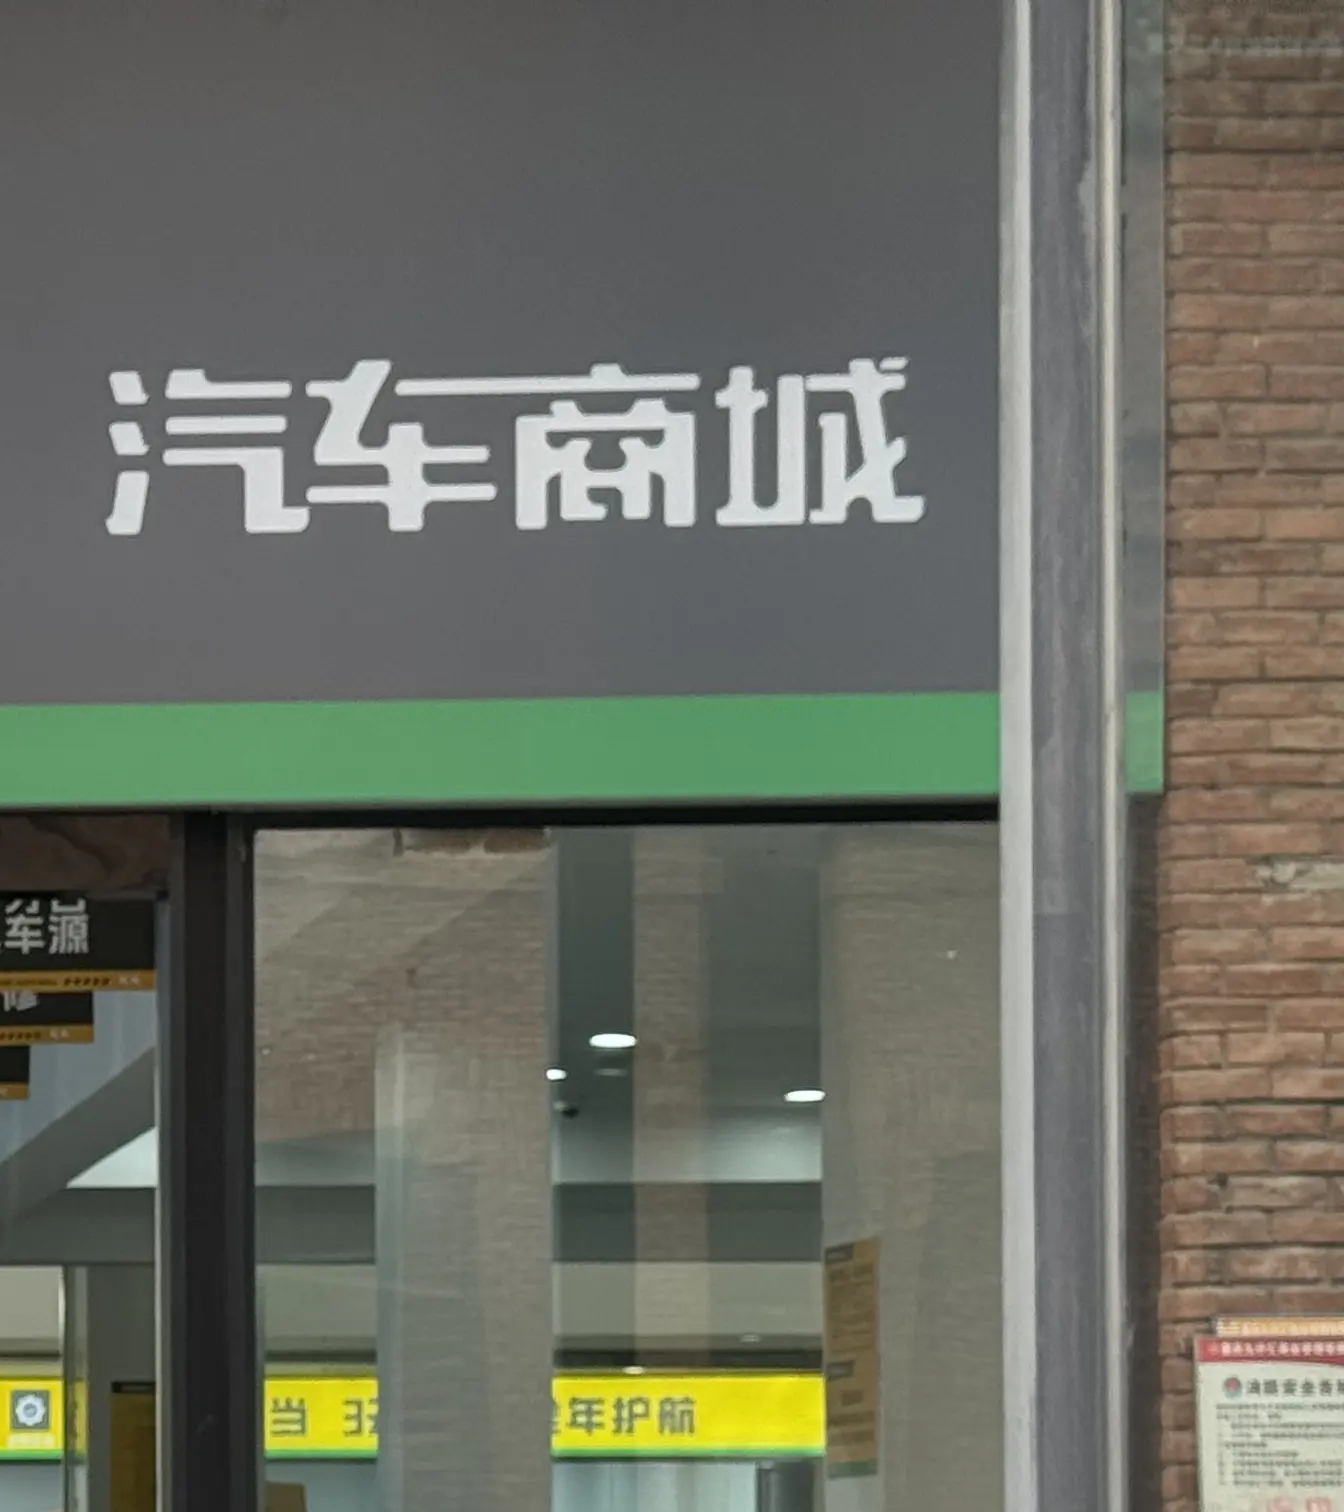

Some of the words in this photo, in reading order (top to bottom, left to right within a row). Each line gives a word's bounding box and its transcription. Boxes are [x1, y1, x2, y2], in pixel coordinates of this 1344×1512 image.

[106, 357, 926, 535] 汽车商城
[551, 1396, 696, 1436] 年护航
